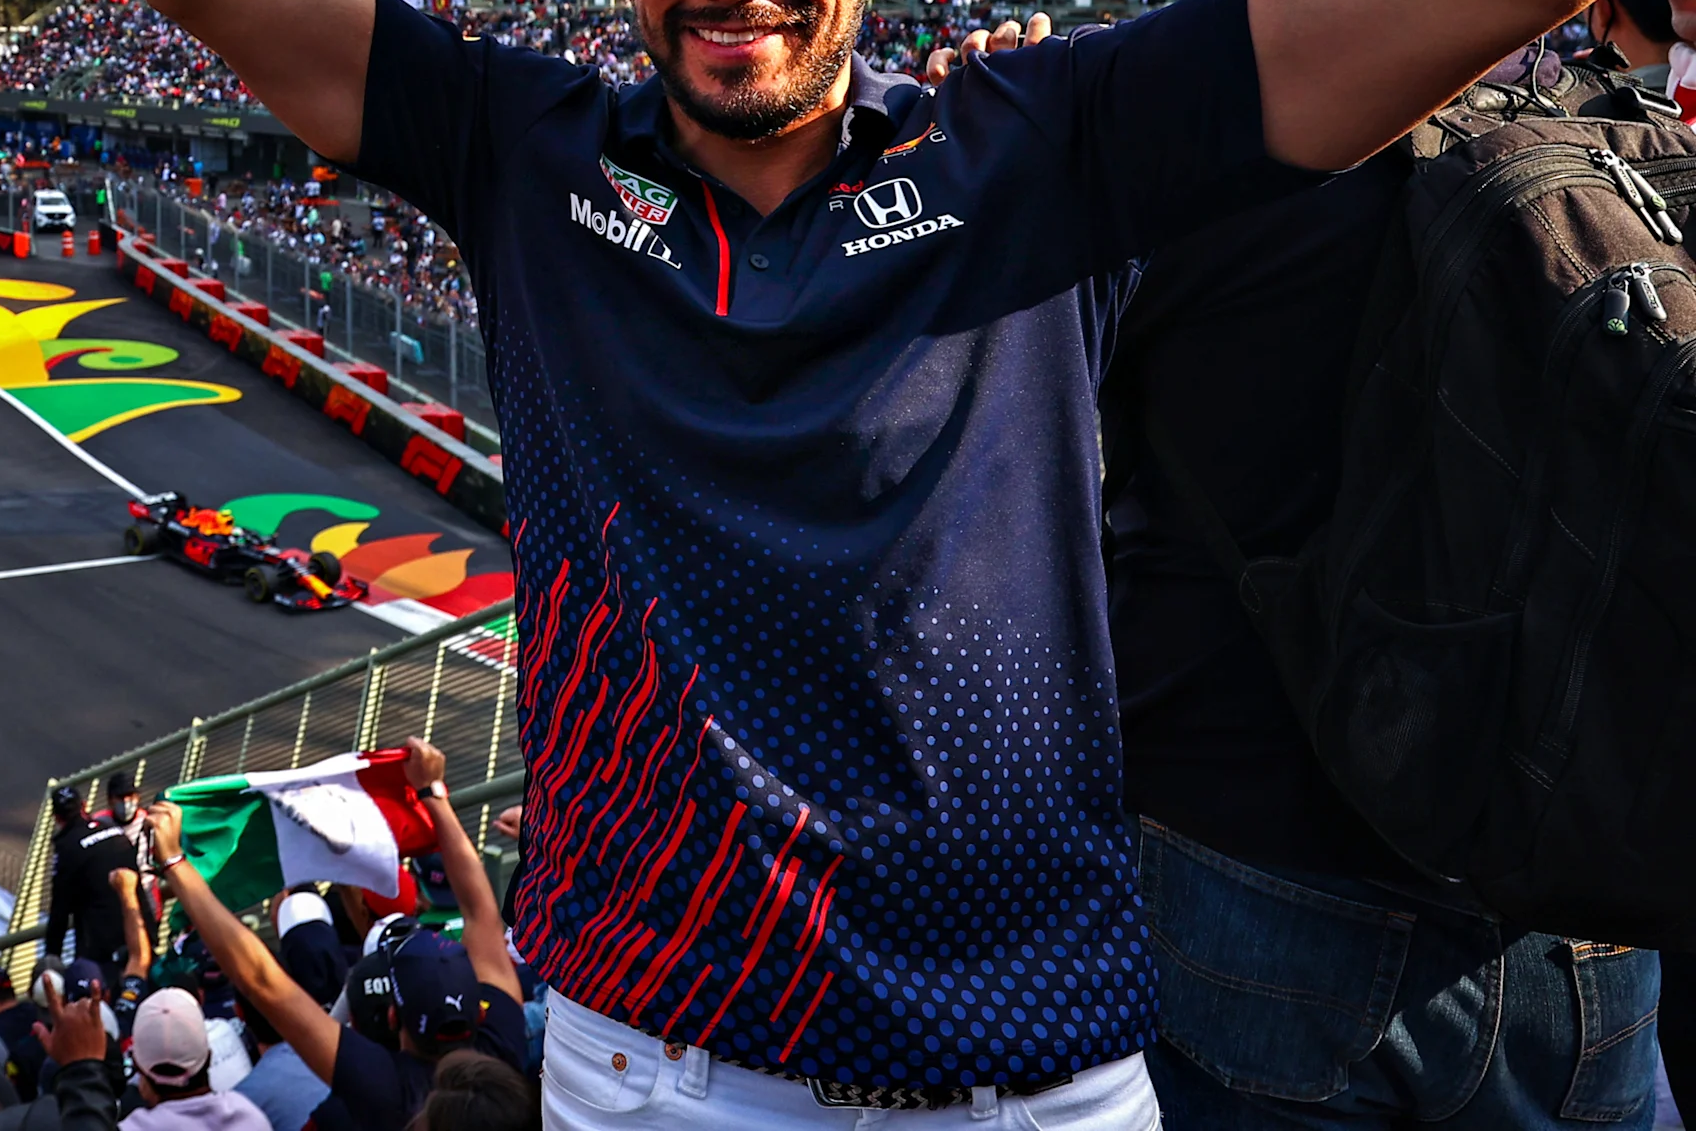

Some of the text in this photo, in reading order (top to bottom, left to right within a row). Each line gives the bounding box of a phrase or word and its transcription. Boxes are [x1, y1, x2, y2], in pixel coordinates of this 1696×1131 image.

[608, 164, 670, 206] TAG
[569, 192, 652, 252] Mobil
[841, 213, 965, 257] HONDA
